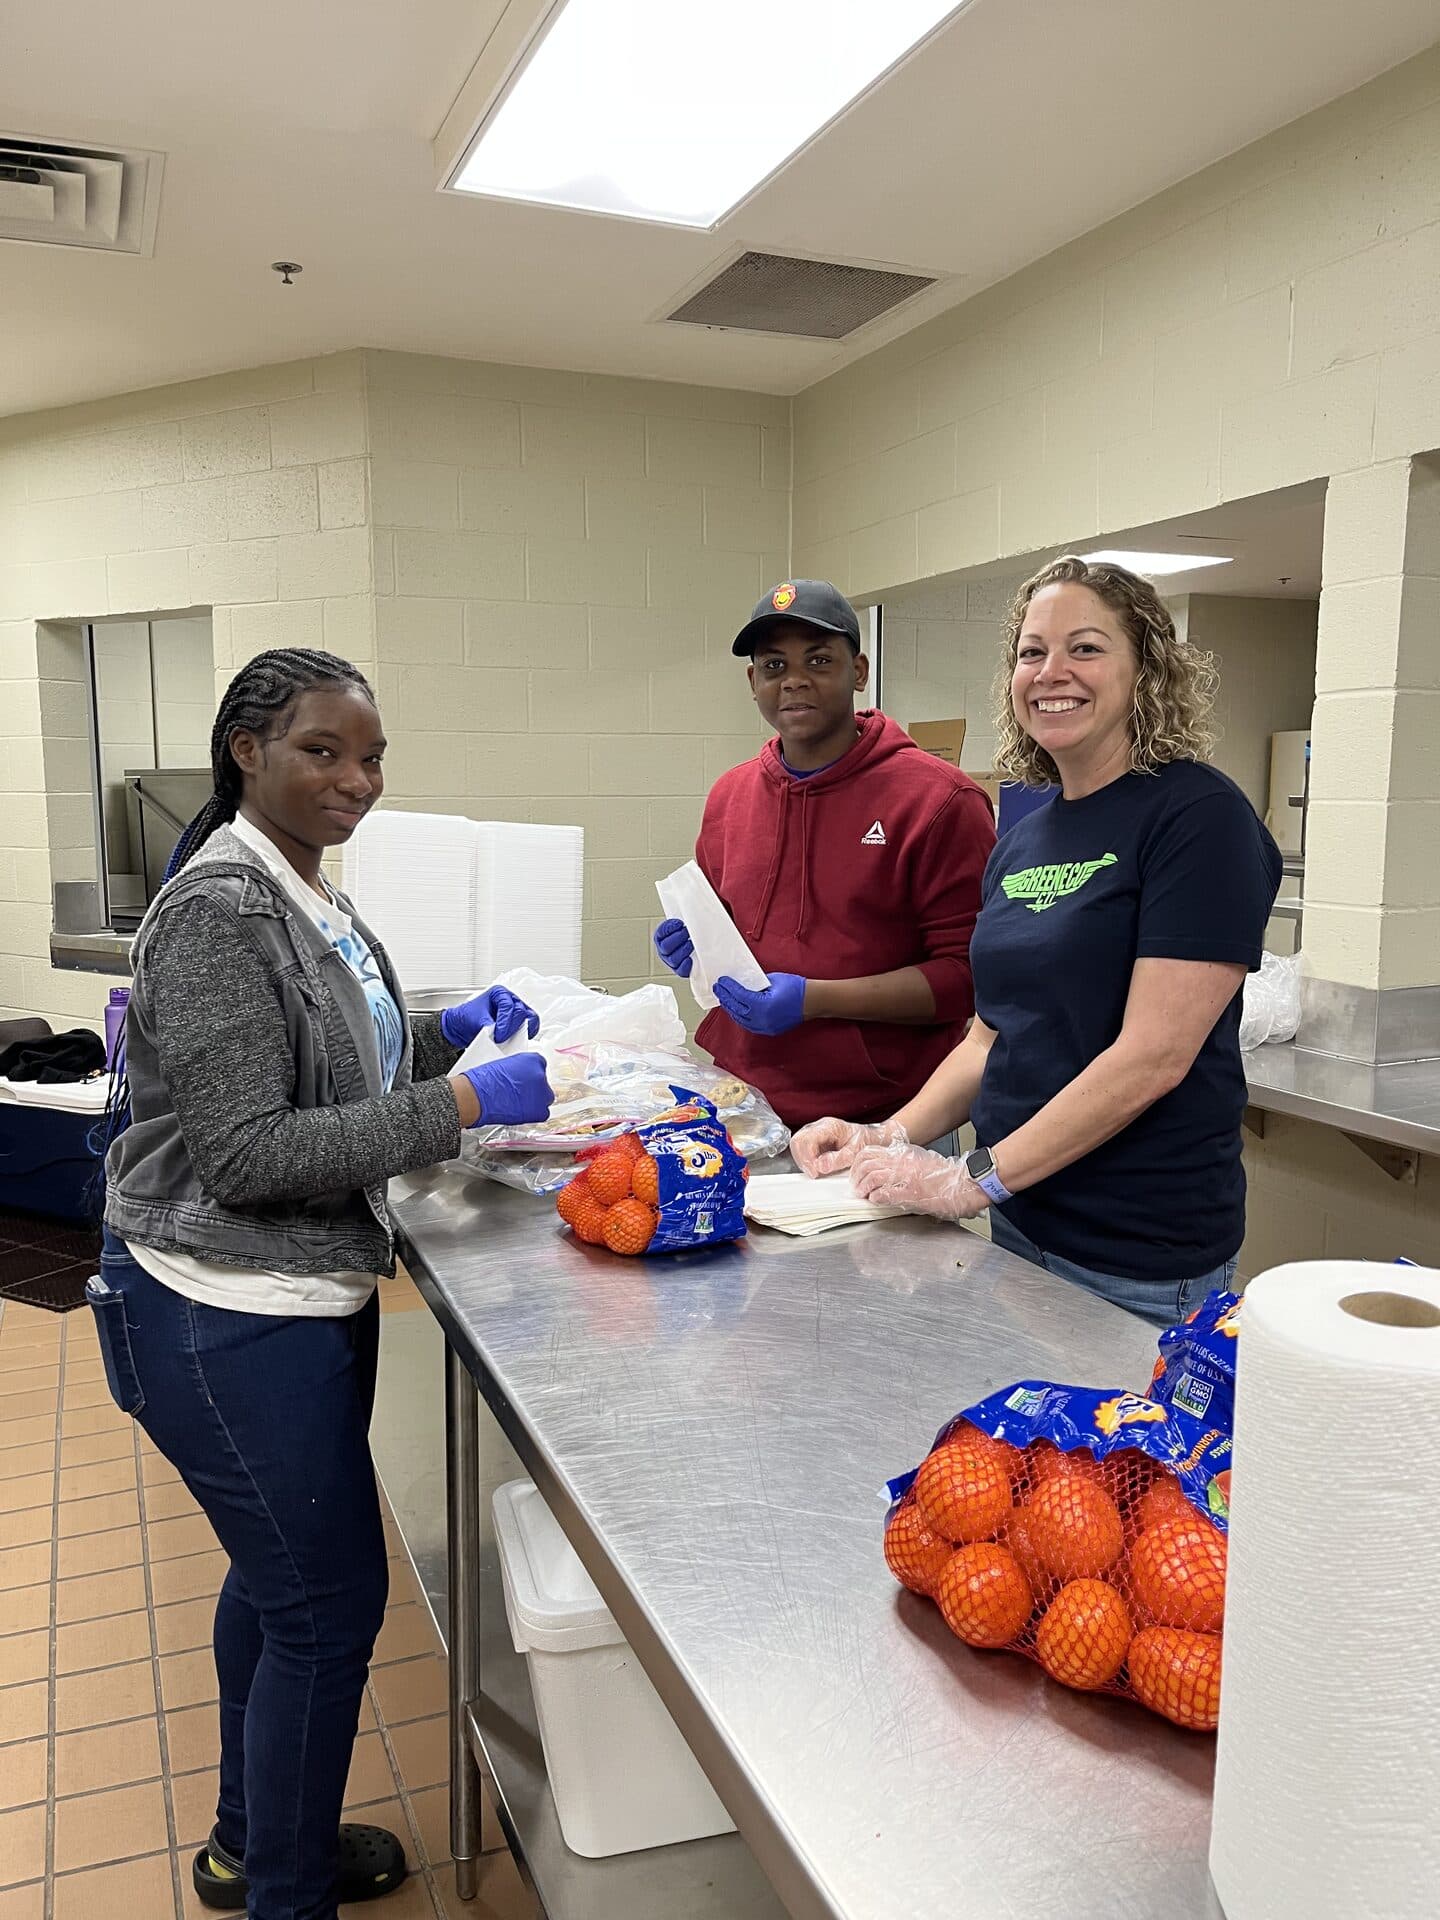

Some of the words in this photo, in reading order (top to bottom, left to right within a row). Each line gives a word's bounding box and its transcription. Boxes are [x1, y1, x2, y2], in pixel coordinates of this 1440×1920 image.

[861, 837, 887, 845] Reebok
[703, 1151, 717, 1160] lbs
[1197, 1363, 1207, 1374] OF
[1192, 1380, 1211, 1393] NON
[1190, 1387, 1209, 1399] GMO
